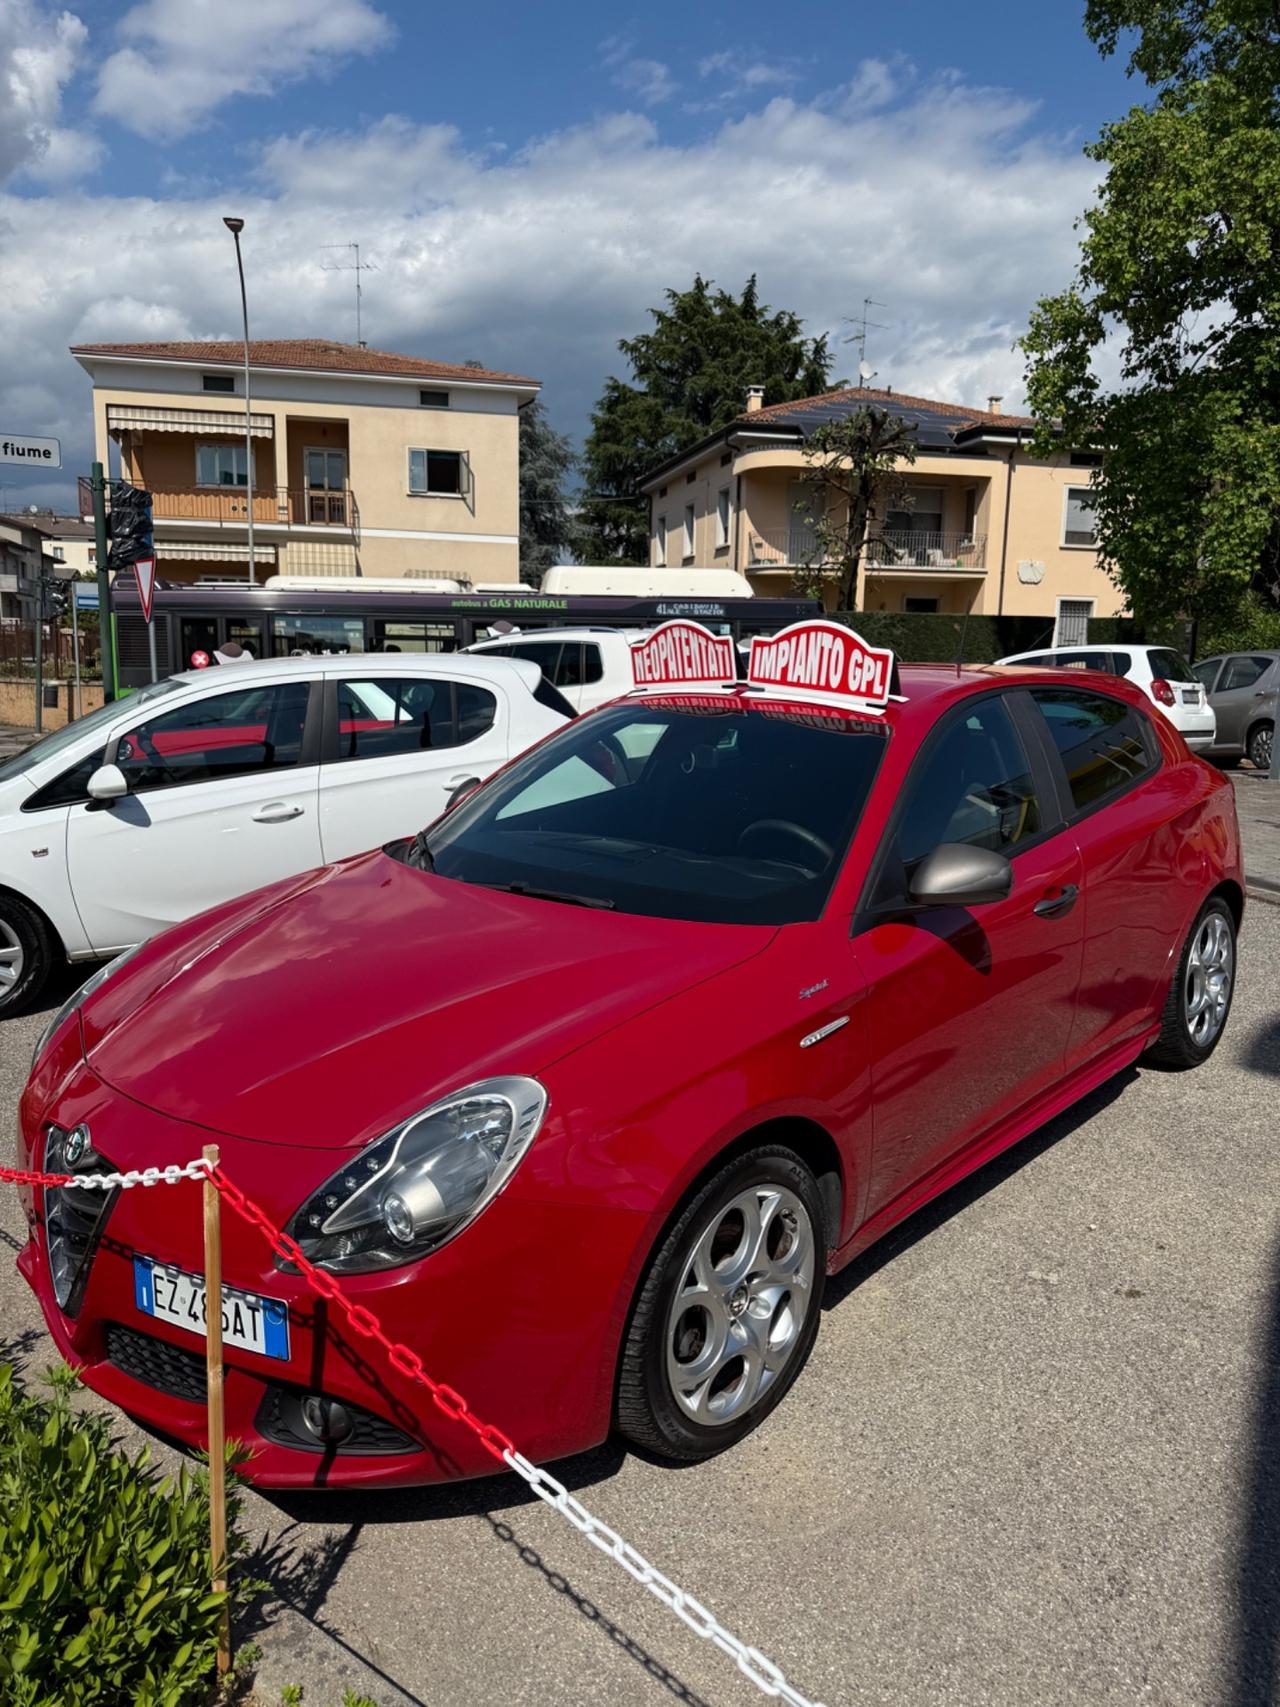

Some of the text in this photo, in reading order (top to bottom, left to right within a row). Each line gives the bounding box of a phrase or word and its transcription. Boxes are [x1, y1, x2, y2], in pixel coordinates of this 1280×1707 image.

[2, 442, 52, 459] fiume
[489, 599, 511, 608] GAS
[514, 599, 568, 609] NATURALE
[656, 603, 667, 615] 41
[634, 627, 730, 682] NEOPATENTATI
[753, 631, 883, 695] IMPIANTO GPL
[153, 1274, 179, 1315] EZ
